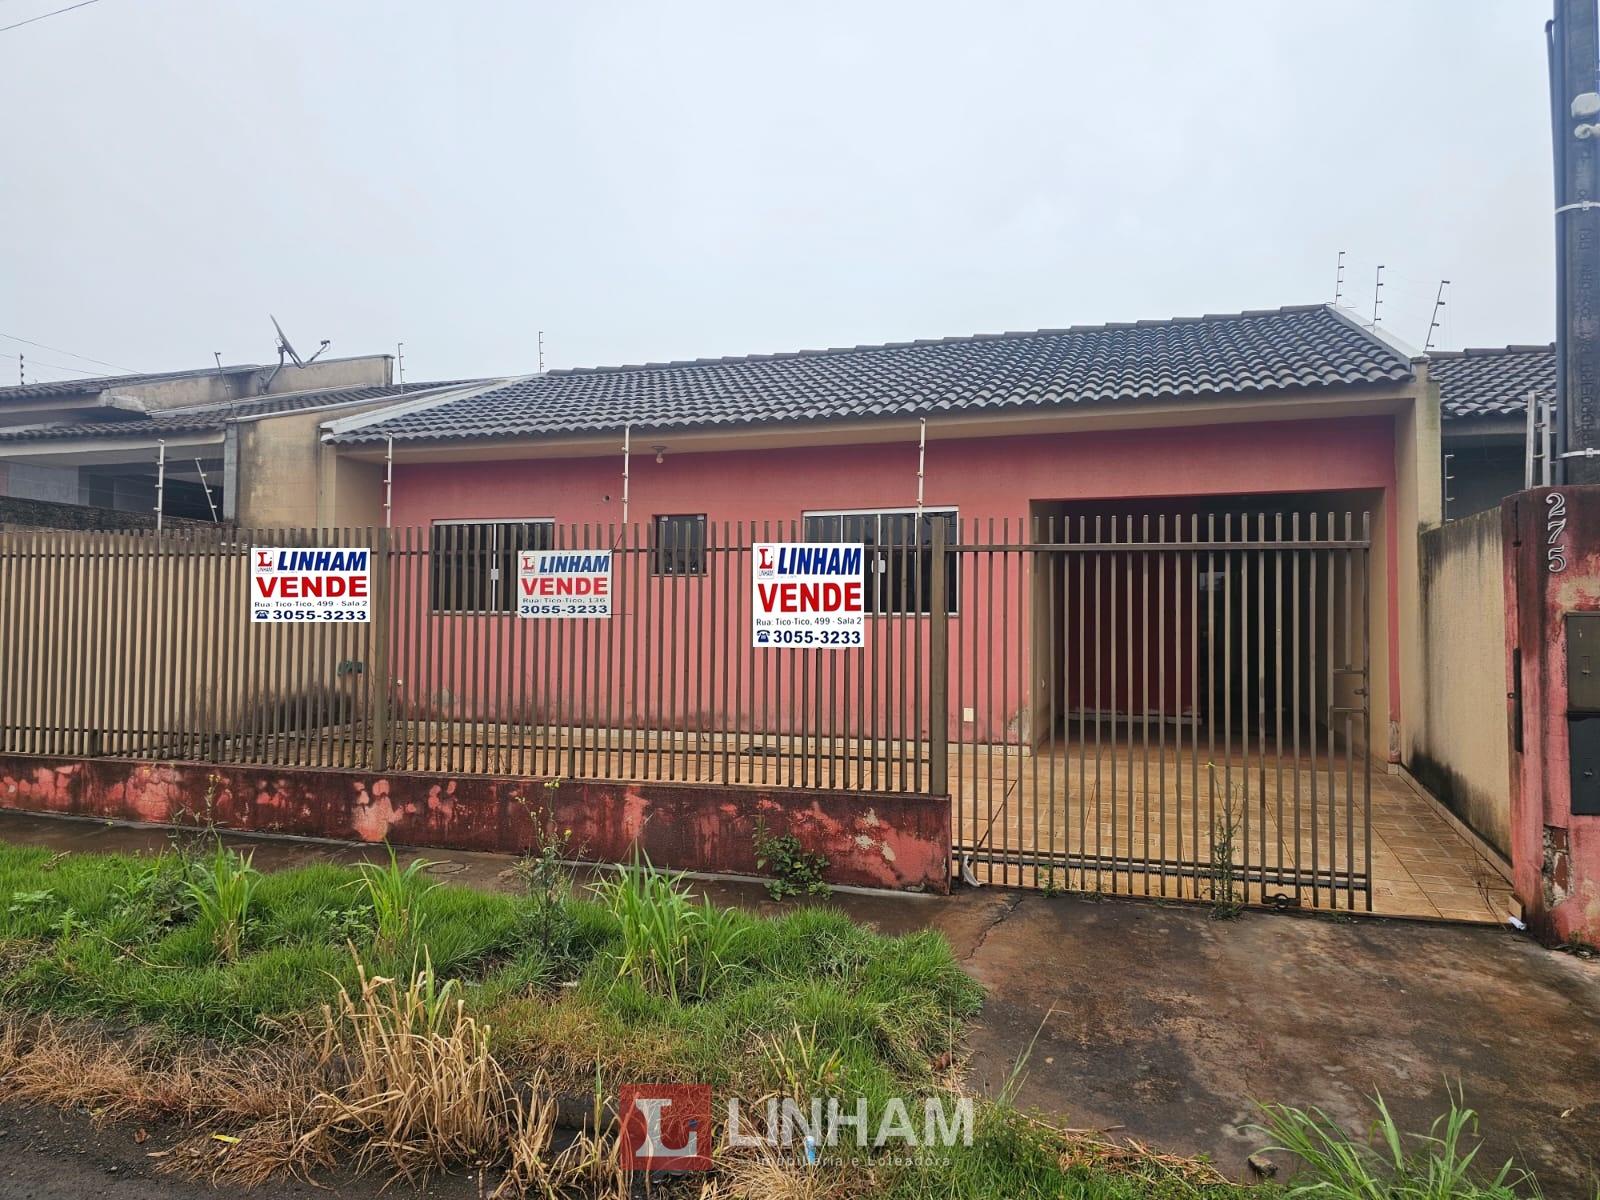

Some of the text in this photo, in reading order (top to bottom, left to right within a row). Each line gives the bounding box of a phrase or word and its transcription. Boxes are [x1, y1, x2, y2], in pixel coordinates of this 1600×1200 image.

[1546, 493, 1567, 572] 275
[277, 551, 367, 571] LINHAM
[539, 555, 610, 573] LINHAM
[777, 547, 861, 575] LINHAM
[256, 576, 367, 598] VENDE
[521, 577, 608, 595] VENDE
[757, 582, 861, 612] VENDE
[273, 610, 366, 620] 3055-3233
[521, 605, 608, 614] 3055-3233
[814, 617, 830, 625] 499
[837, 617, 855, 625] Sala
[773, 630, 861, 644] 3055-3233
